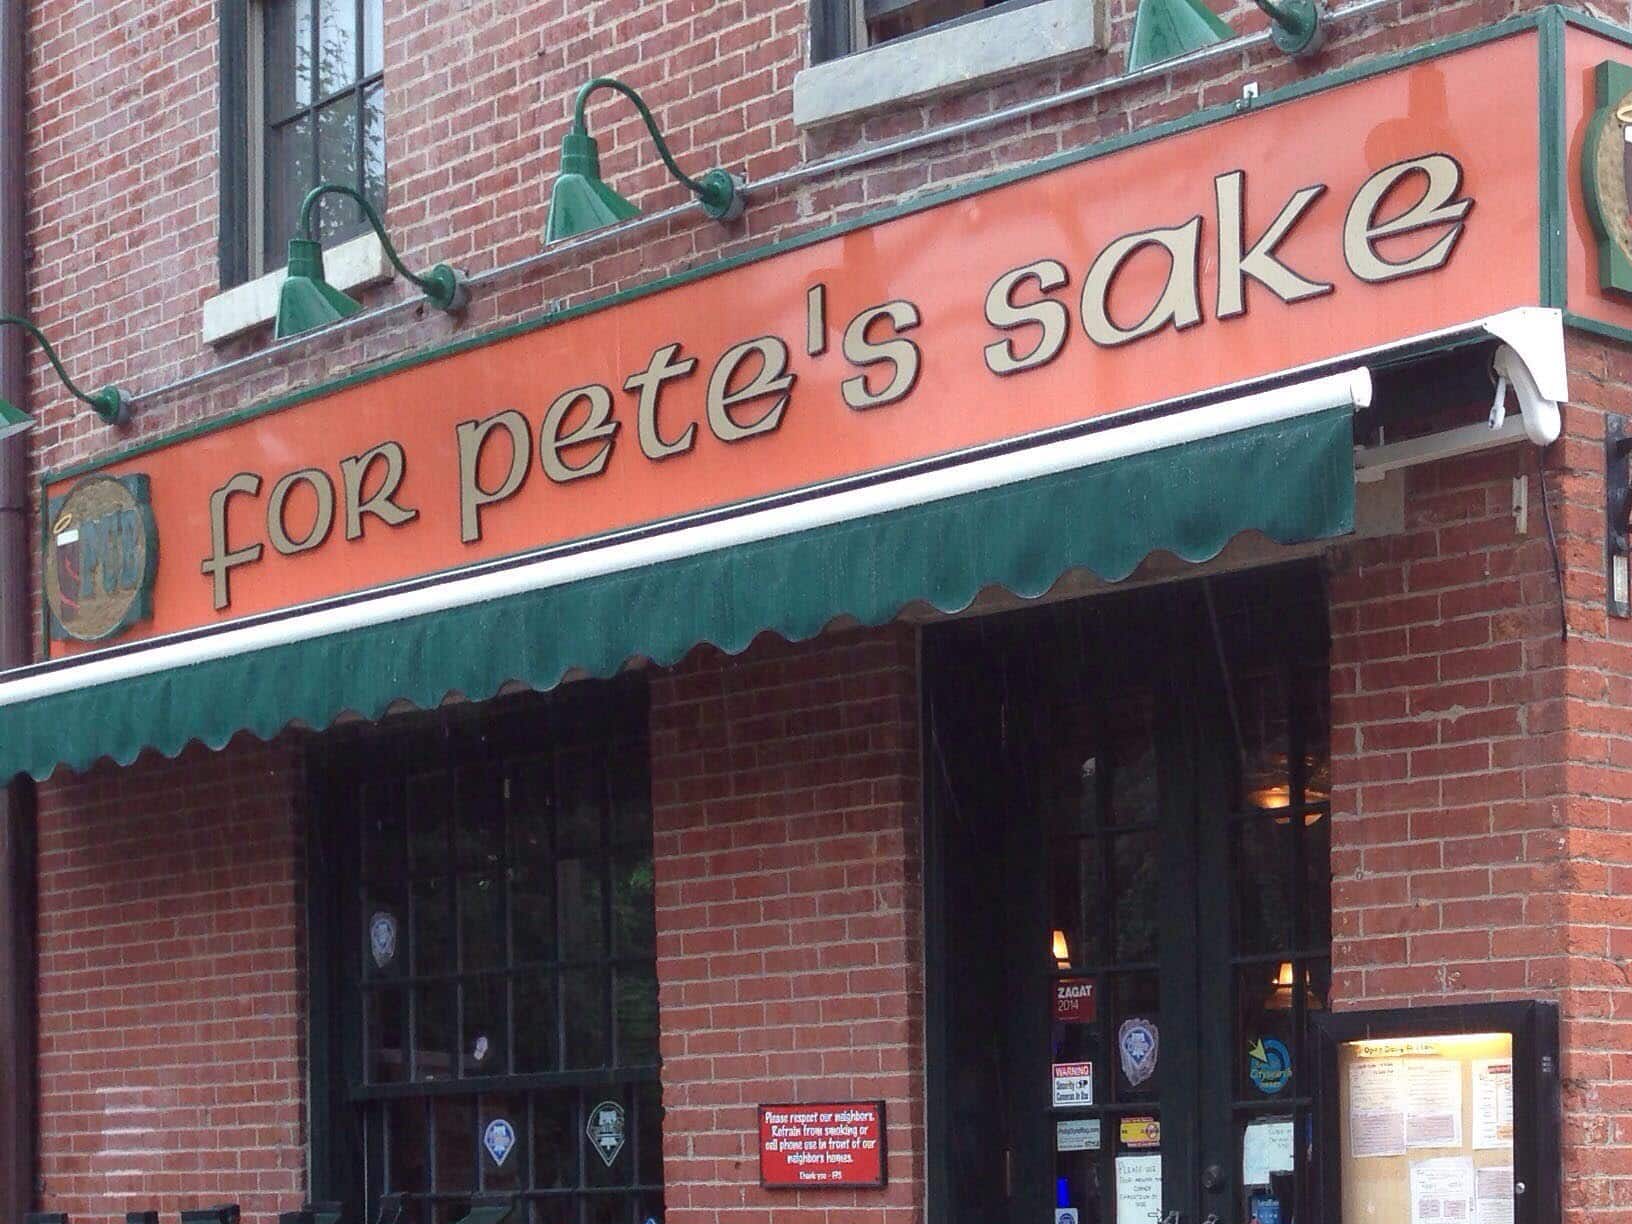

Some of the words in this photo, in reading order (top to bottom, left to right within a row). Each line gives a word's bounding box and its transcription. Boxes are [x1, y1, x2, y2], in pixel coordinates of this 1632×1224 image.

[457, 284, 921, 544] pete's
[983, 152, 1475, 376] sake
[80, 509, 139, 598] PUB
[1057, 985, 1093, 999] ZAGAT
[1057, 999, 1079, 1012] 2014
[1055, 1065, 1089, 1077] WARNING
[765, 1112, 788, 1124] Please
[790, 1111, 818, 1125] respect
[771, 1125, 801, 1136] Refrain
[803, 1124, 823, 1136] from
[825, 1124, 858, 1137] smoking
[860, 1125, 869, 1136] or
[780, 1139, 802, 1152] phone
[828, 1138, 850, 1150] front
[852, 1138, 861, 1149] of
